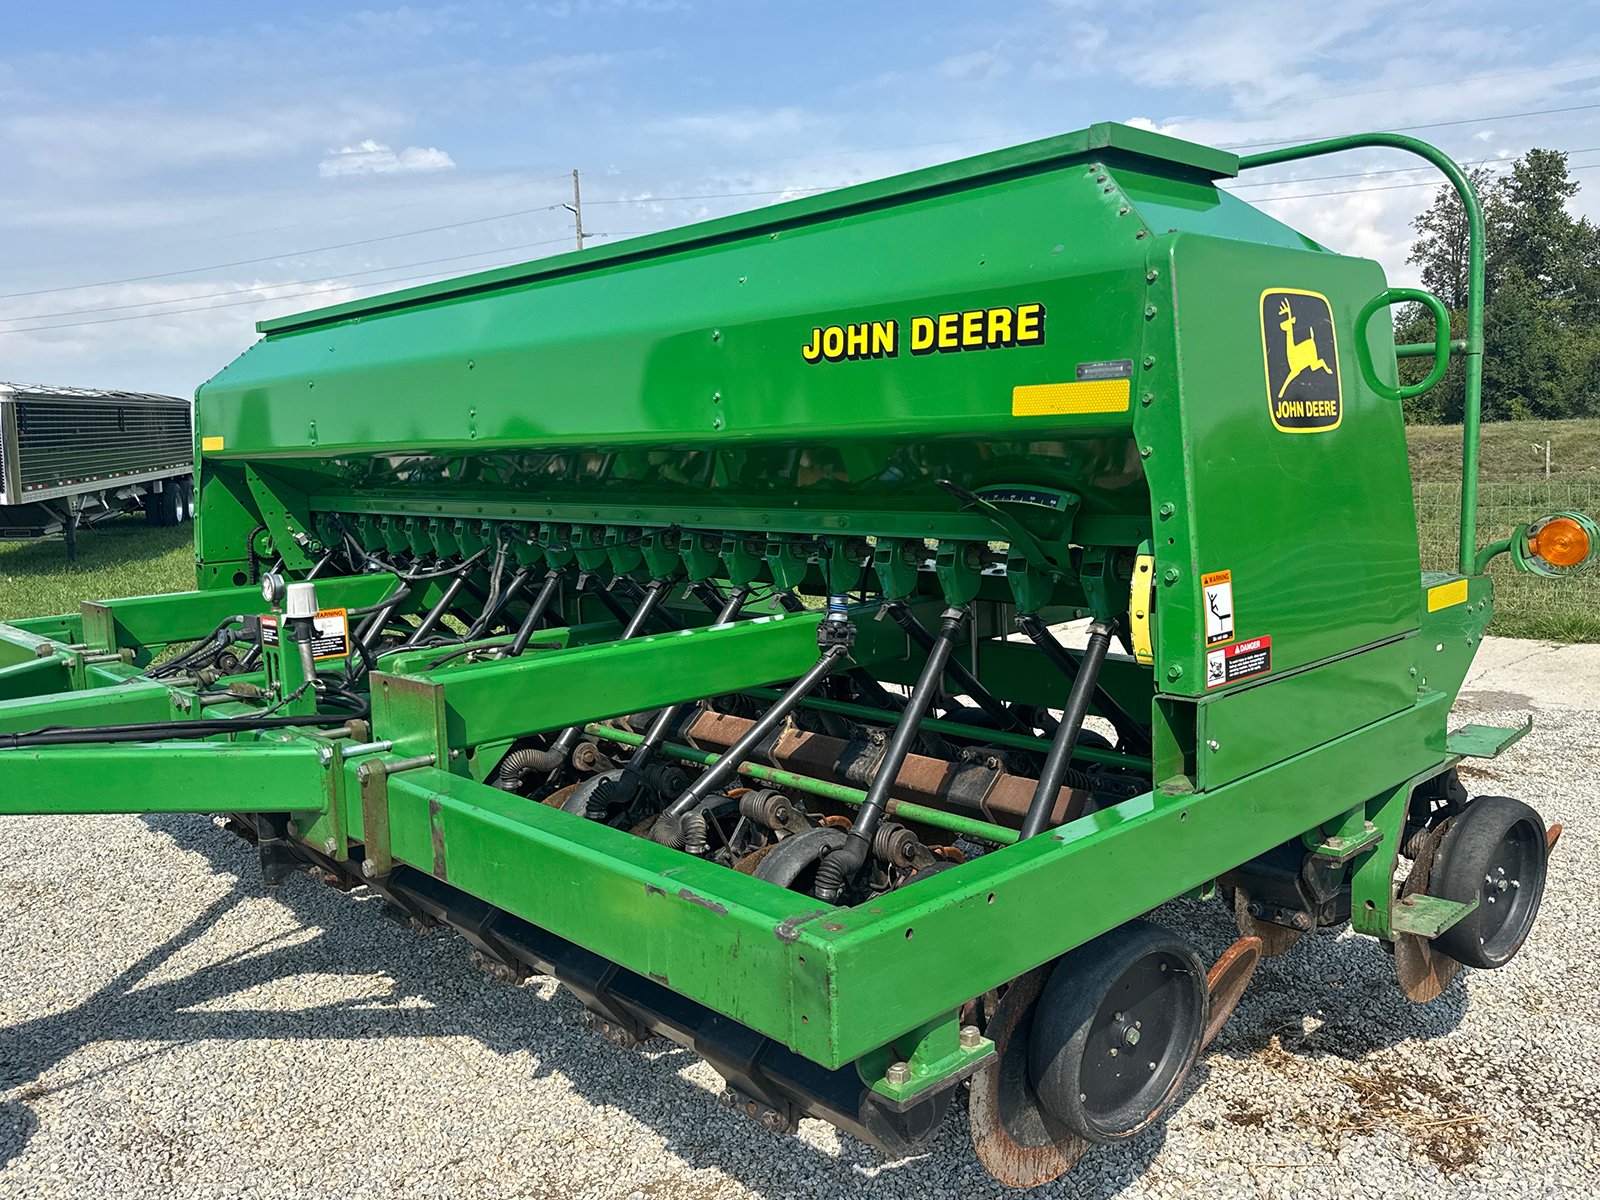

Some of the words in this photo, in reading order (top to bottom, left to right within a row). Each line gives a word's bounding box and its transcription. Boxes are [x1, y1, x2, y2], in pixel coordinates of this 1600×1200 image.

[802, 319, 898, 363] JOHN
[911, 303, 1046, 355] DEERE
[1276, 401, 1304, 418] JOHN
[1306, 400, 1337, 416] DEERE
[1240, 640, 1261, 652] DANGER
